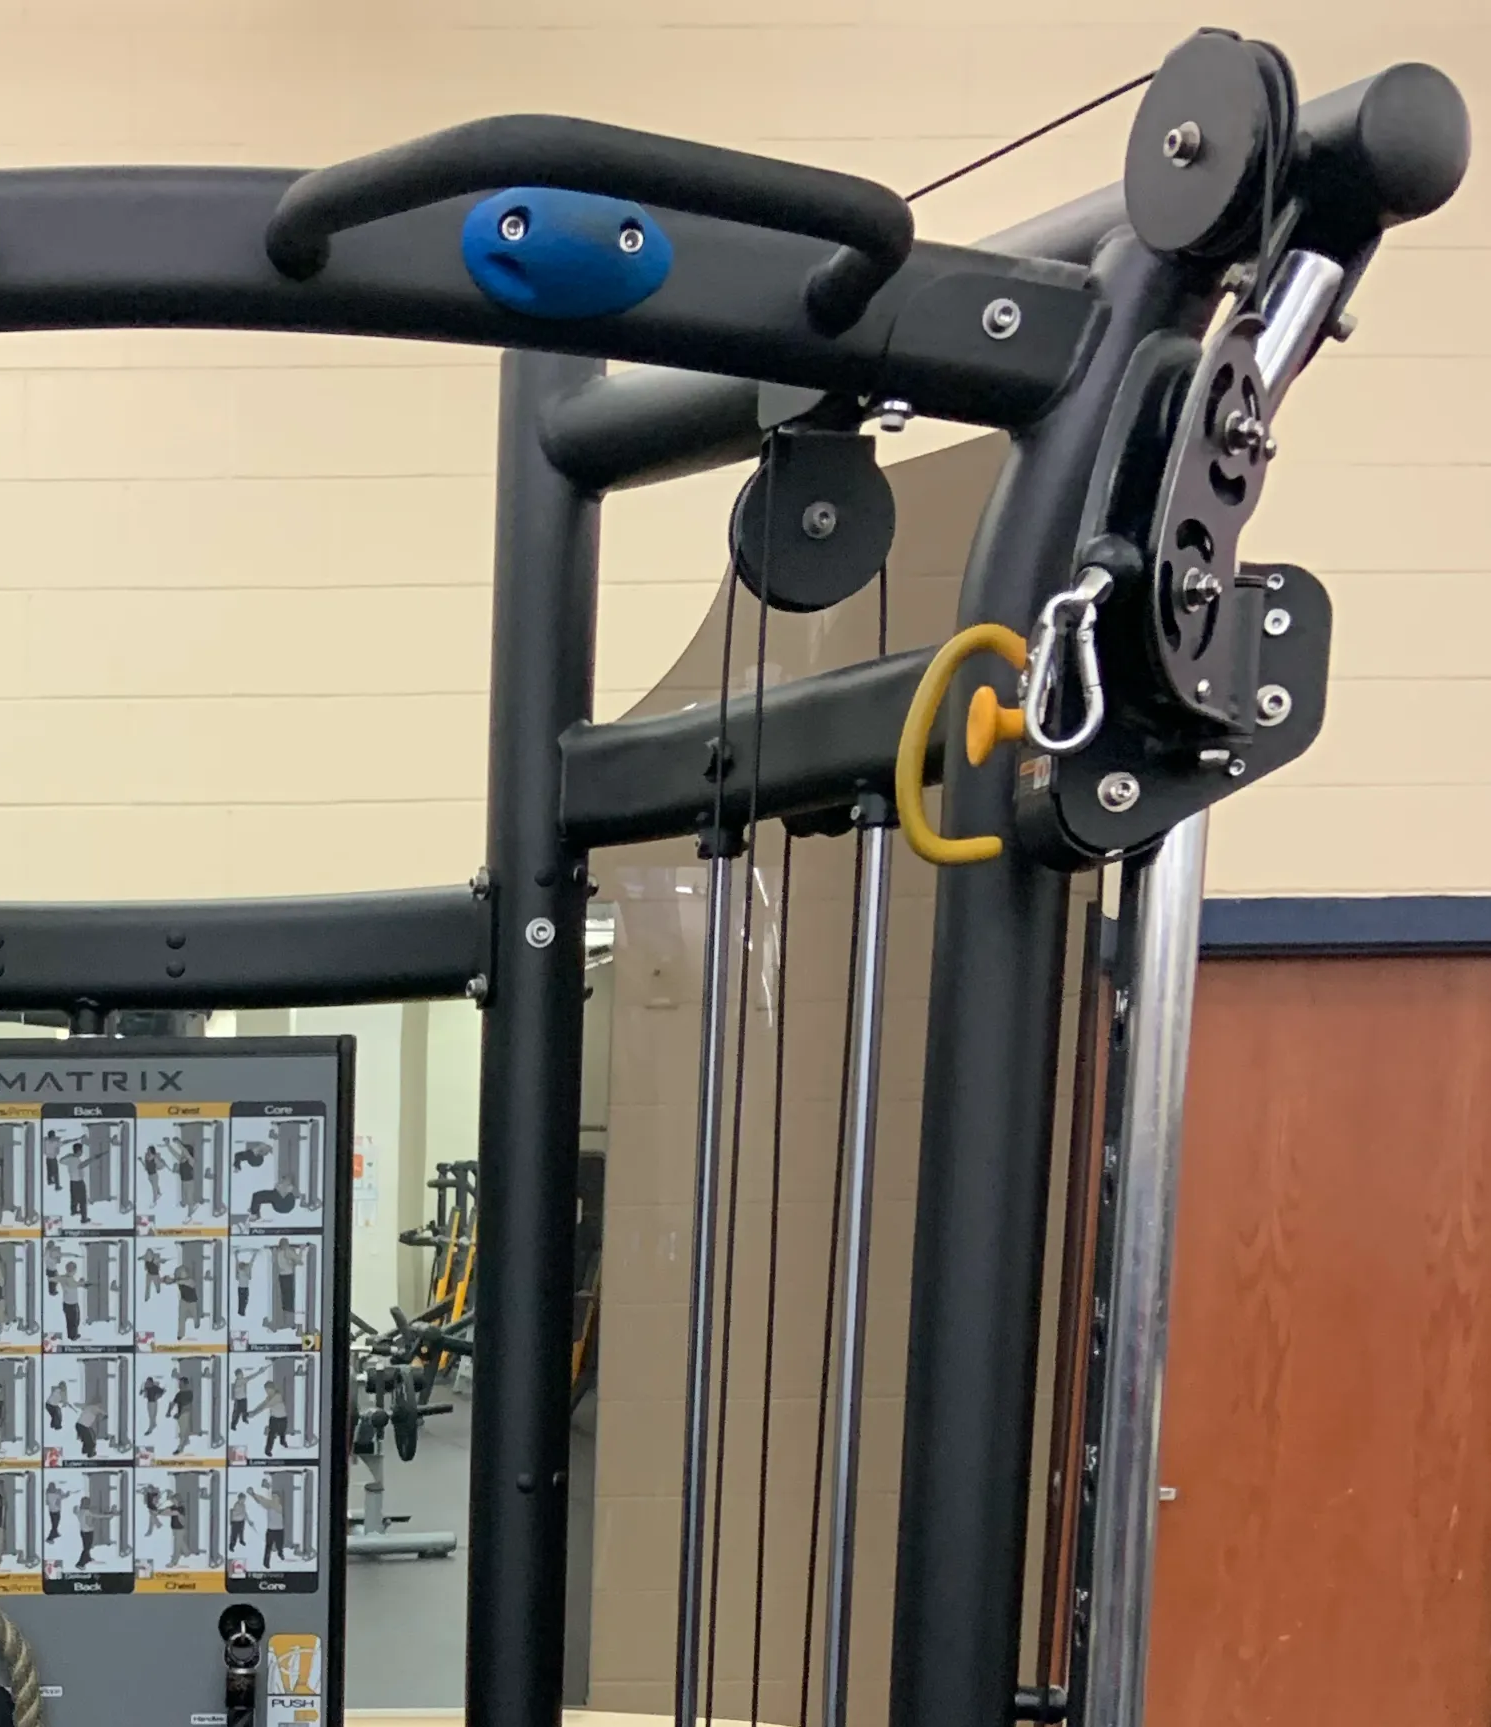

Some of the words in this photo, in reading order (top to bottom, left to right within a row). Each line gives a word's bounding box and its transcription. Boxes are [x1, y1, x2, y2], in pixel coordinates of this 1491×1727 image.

[73, 1106, 103, 1117] Back
[167, 1105, 201, 1116] Chest
[264, 1105, 294, 1115] Core
[73, 1582, 102, 1592] Back
[164, 1580, 197, 1590] Chest
[258, 1581, 287, 1591] Core
[271, 1699, 315, 1709] PUSH
